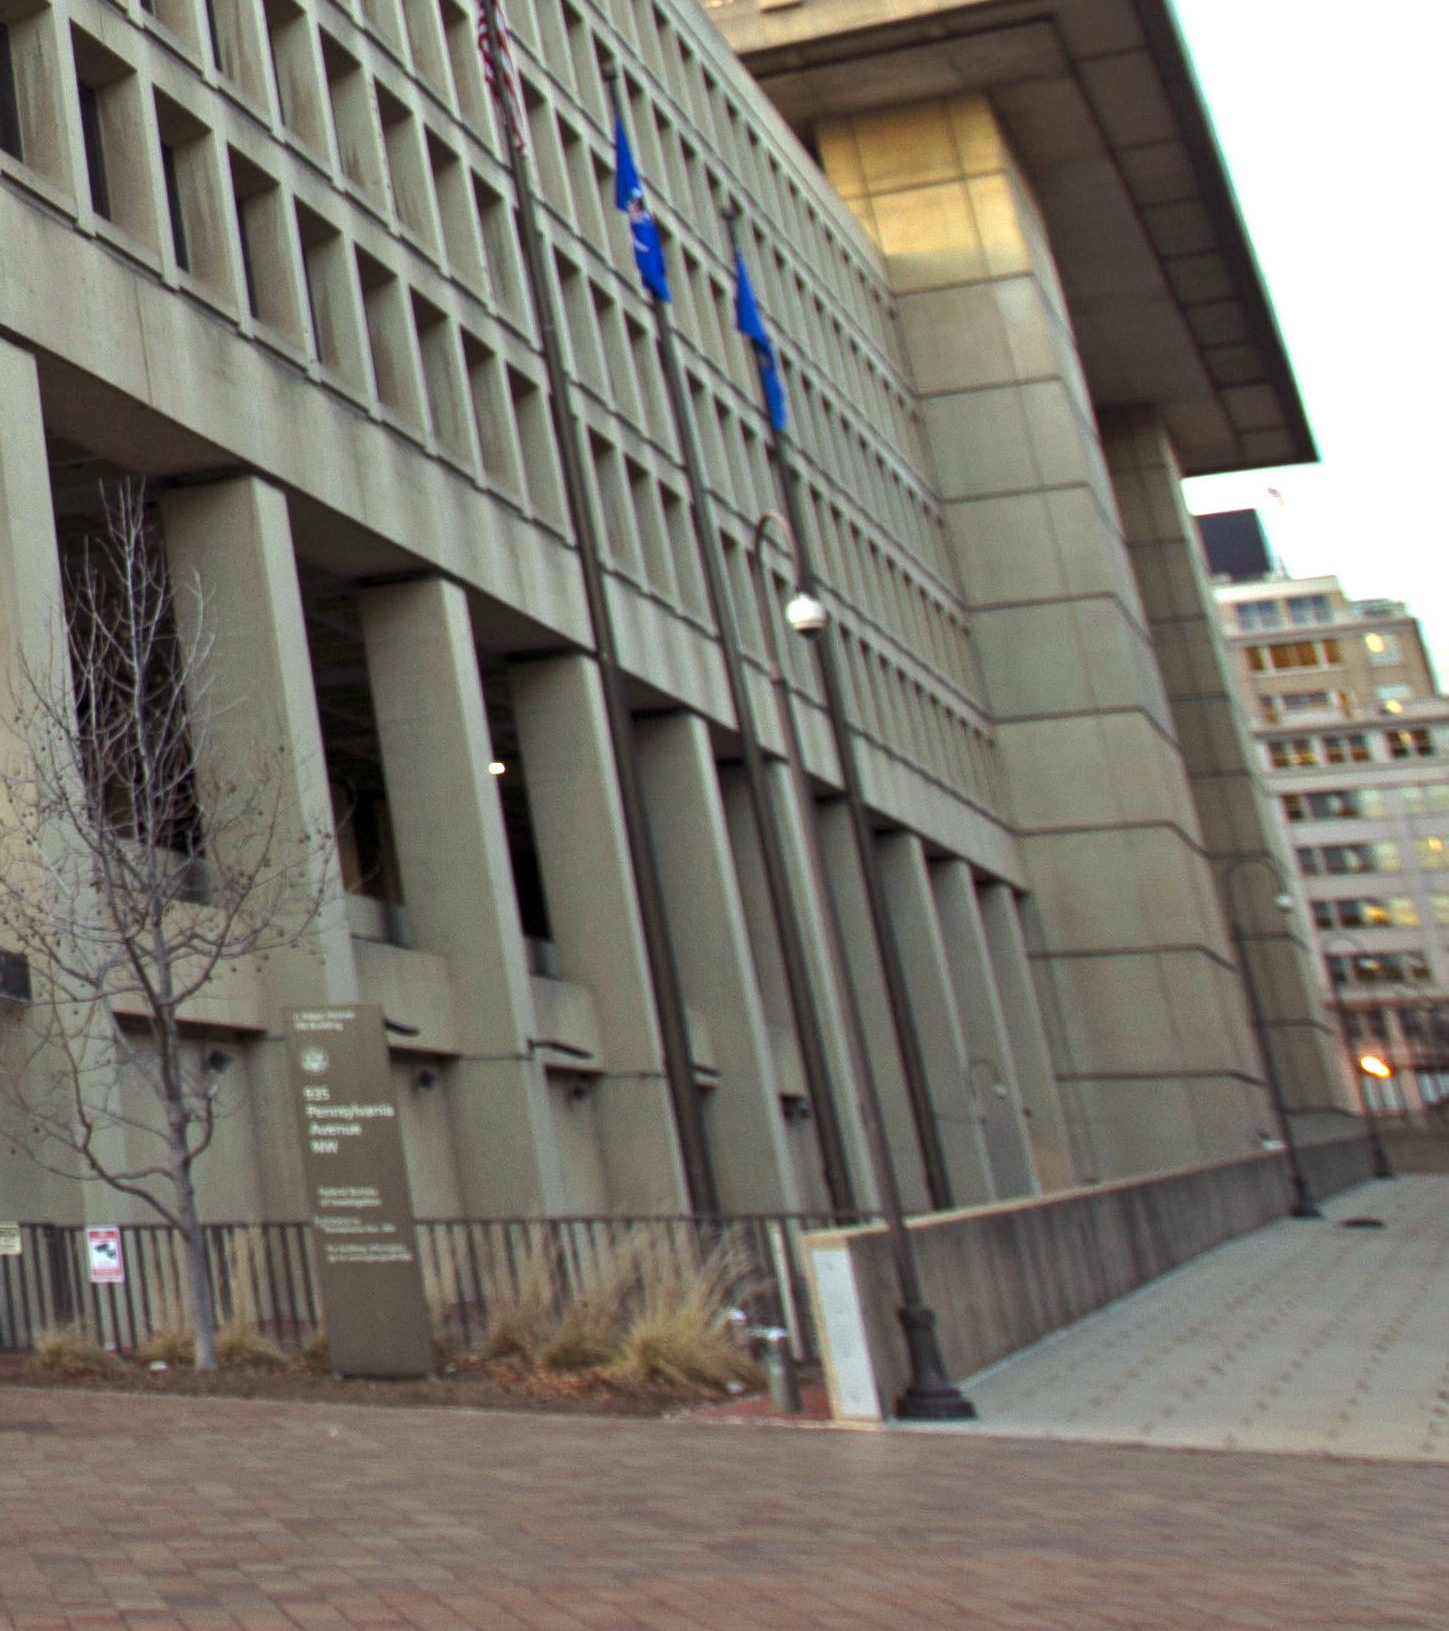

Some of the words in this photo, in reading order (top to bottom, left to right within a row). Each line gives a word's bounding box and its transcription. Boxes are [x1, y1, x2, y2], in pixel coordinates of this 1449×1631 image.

[303, 1084, 330, 1101] 935
[305, 1101, 395, 1121] Pennsylvania
[309, 1120, 363, 1137] Avenue
[310, 1138, 339, 1154] NW
